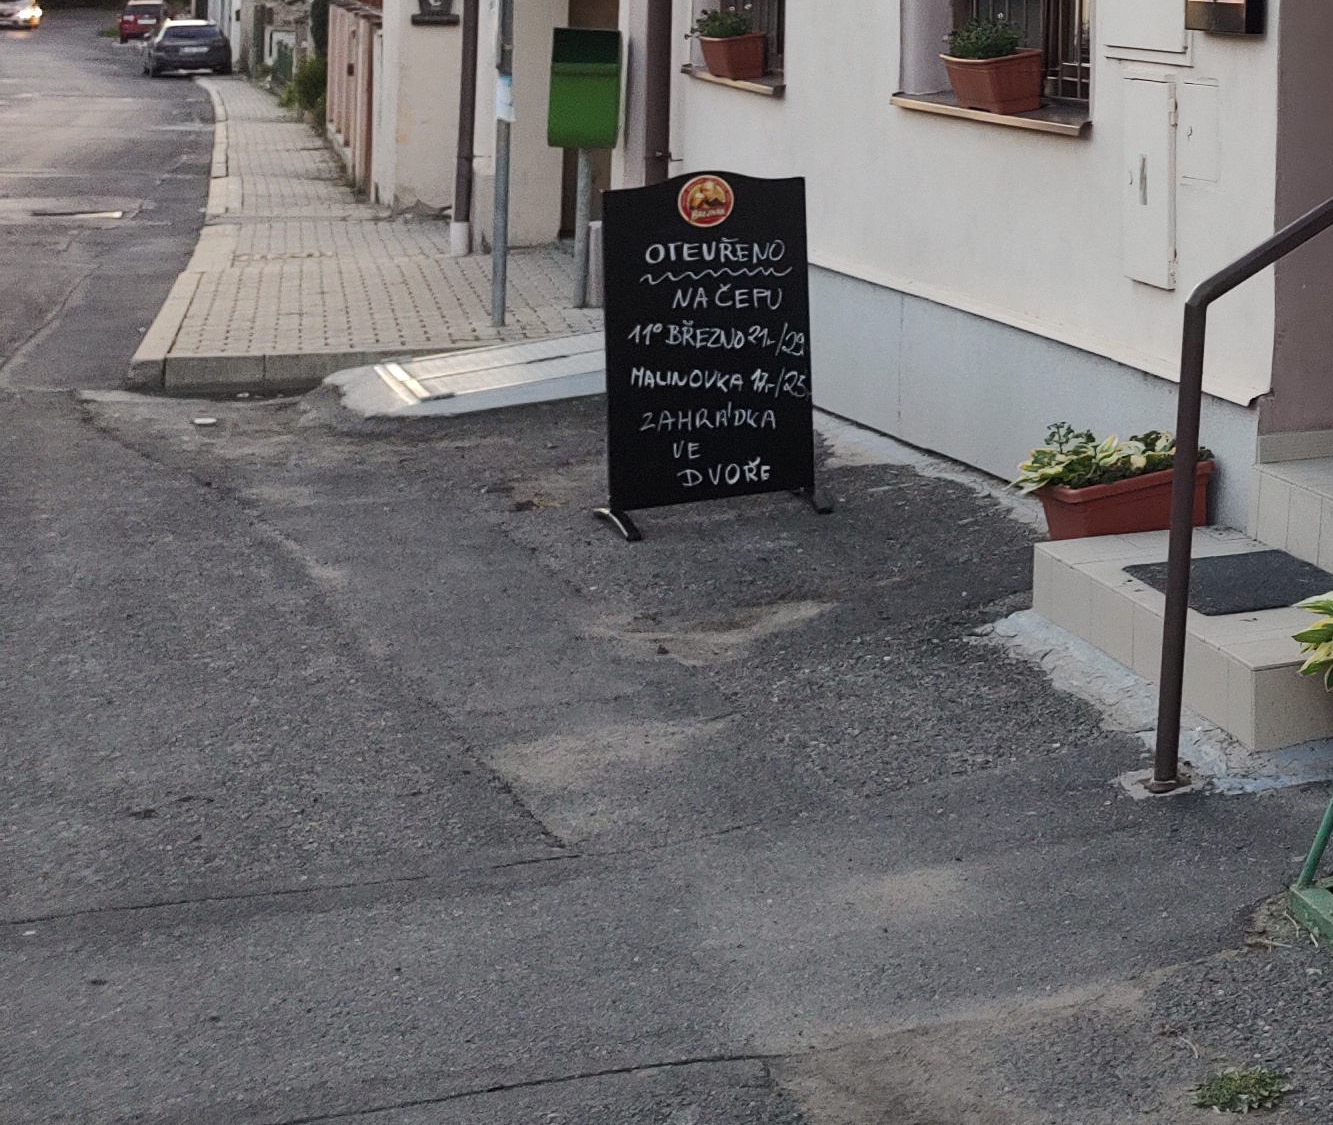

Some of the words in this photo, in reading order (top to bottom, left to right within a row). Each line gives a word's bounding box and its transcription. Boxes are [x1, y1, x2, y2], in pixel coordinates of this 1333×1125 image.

[645, 237, 786, 264] OTEVŘENO
[672, 288, 708, 309] NA
[714, 283, 783, 310] ČEPU
[665, 320, 745, 349] BŘEZNO
[639, 401, 777, 432] ZAHRÁDKA
[672, 440, 700, 459] VE
[676, 457, 771, 487] DVOŘE
